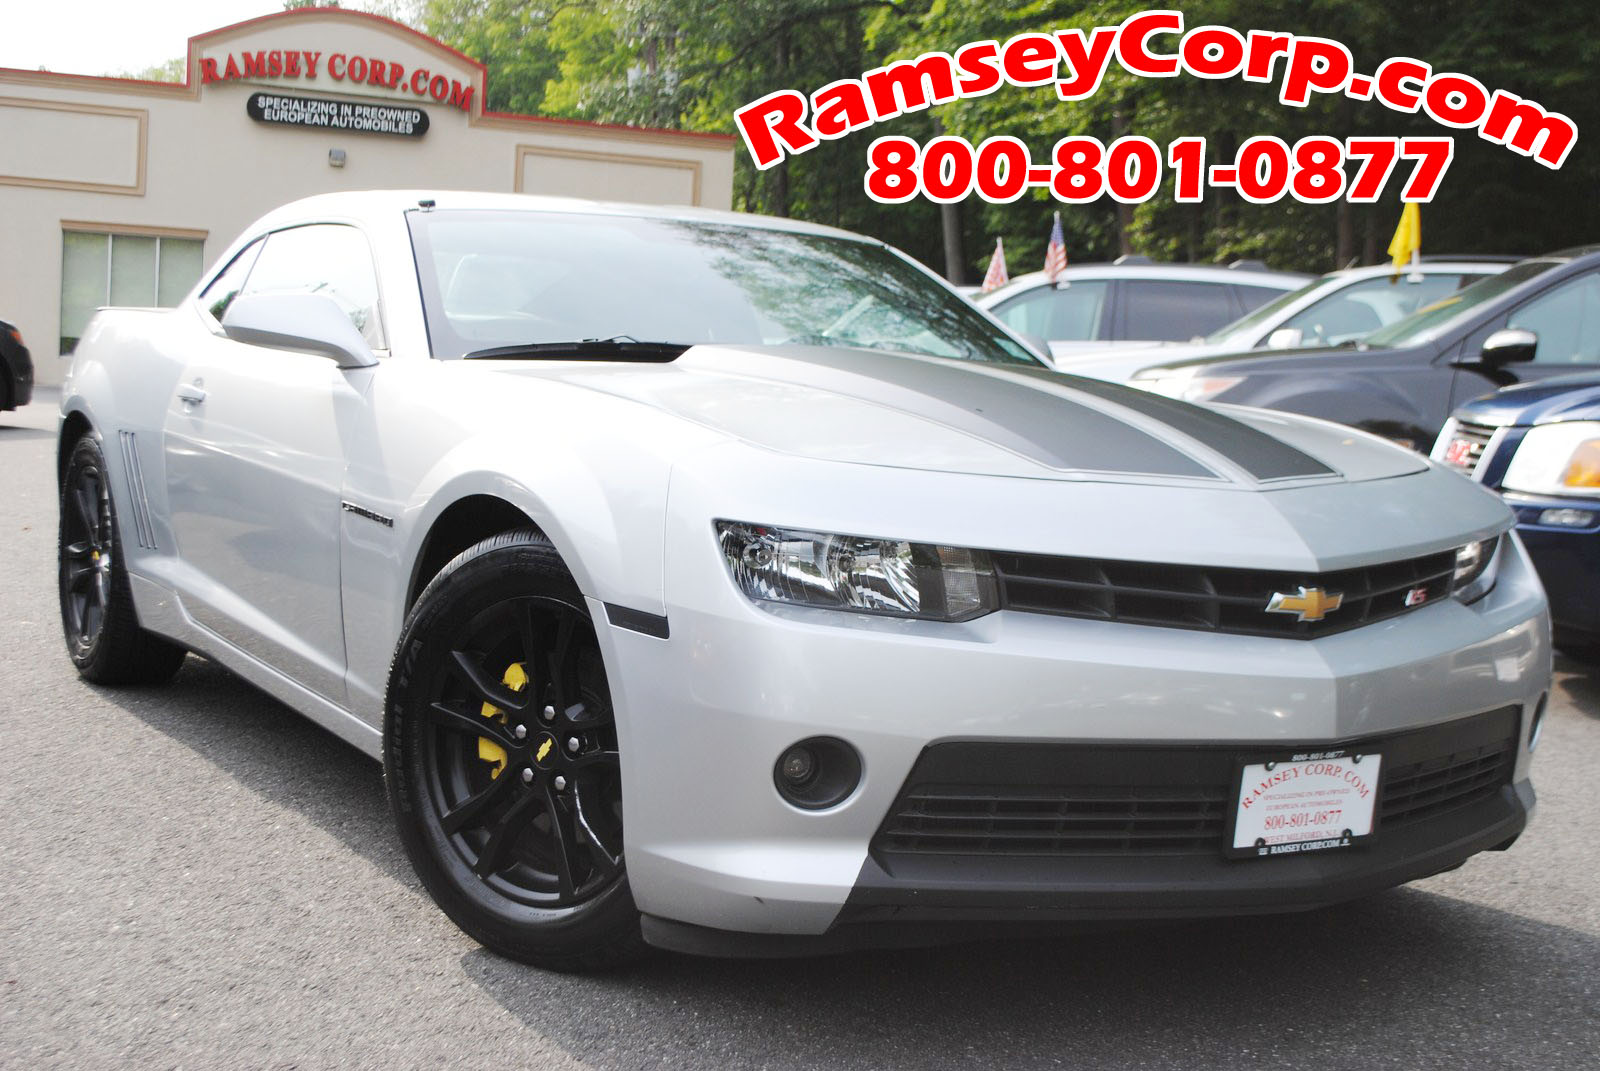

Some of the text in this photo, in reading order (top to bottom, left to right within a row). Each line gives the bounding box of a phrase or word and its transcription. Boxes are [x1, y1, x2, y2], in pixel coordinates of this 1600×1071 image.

[199, 50, 476, 111] RAMSEY CORP.COM
[257, 95, 421, 124] SPECIALIZING IN PREOWNED
[264, 108, 414, 135] EUROPEAN AUTOMOBILES
[1242, 767, 1301, 809] RAMSEY
[1264, 809, 1342, 830] 800-801-0877
